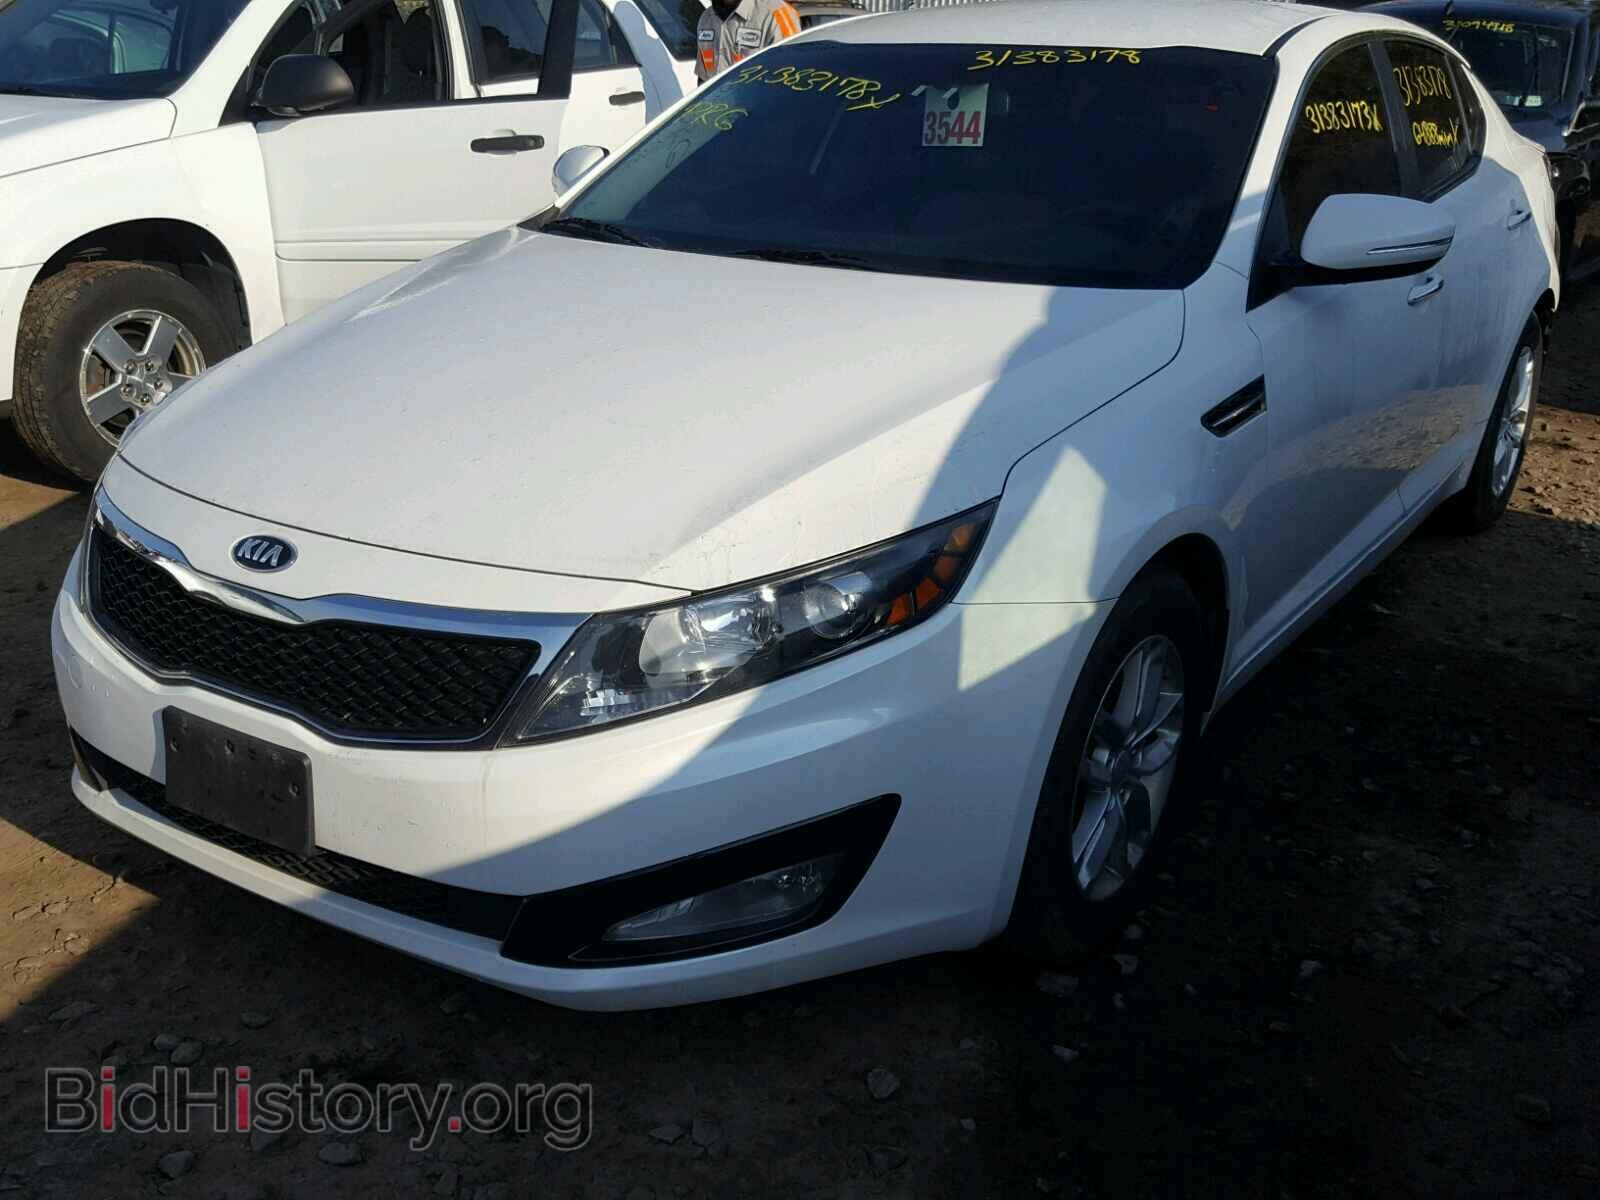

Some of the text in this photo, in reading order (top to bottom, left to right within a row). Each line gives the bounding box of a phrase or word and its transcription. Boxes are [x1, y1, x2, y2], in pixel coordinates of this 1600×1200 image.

[967, 49, 1142, 70] 31383178
[925, 110, 981, 144] 3544
[237, 539, 284, 567] KIA
